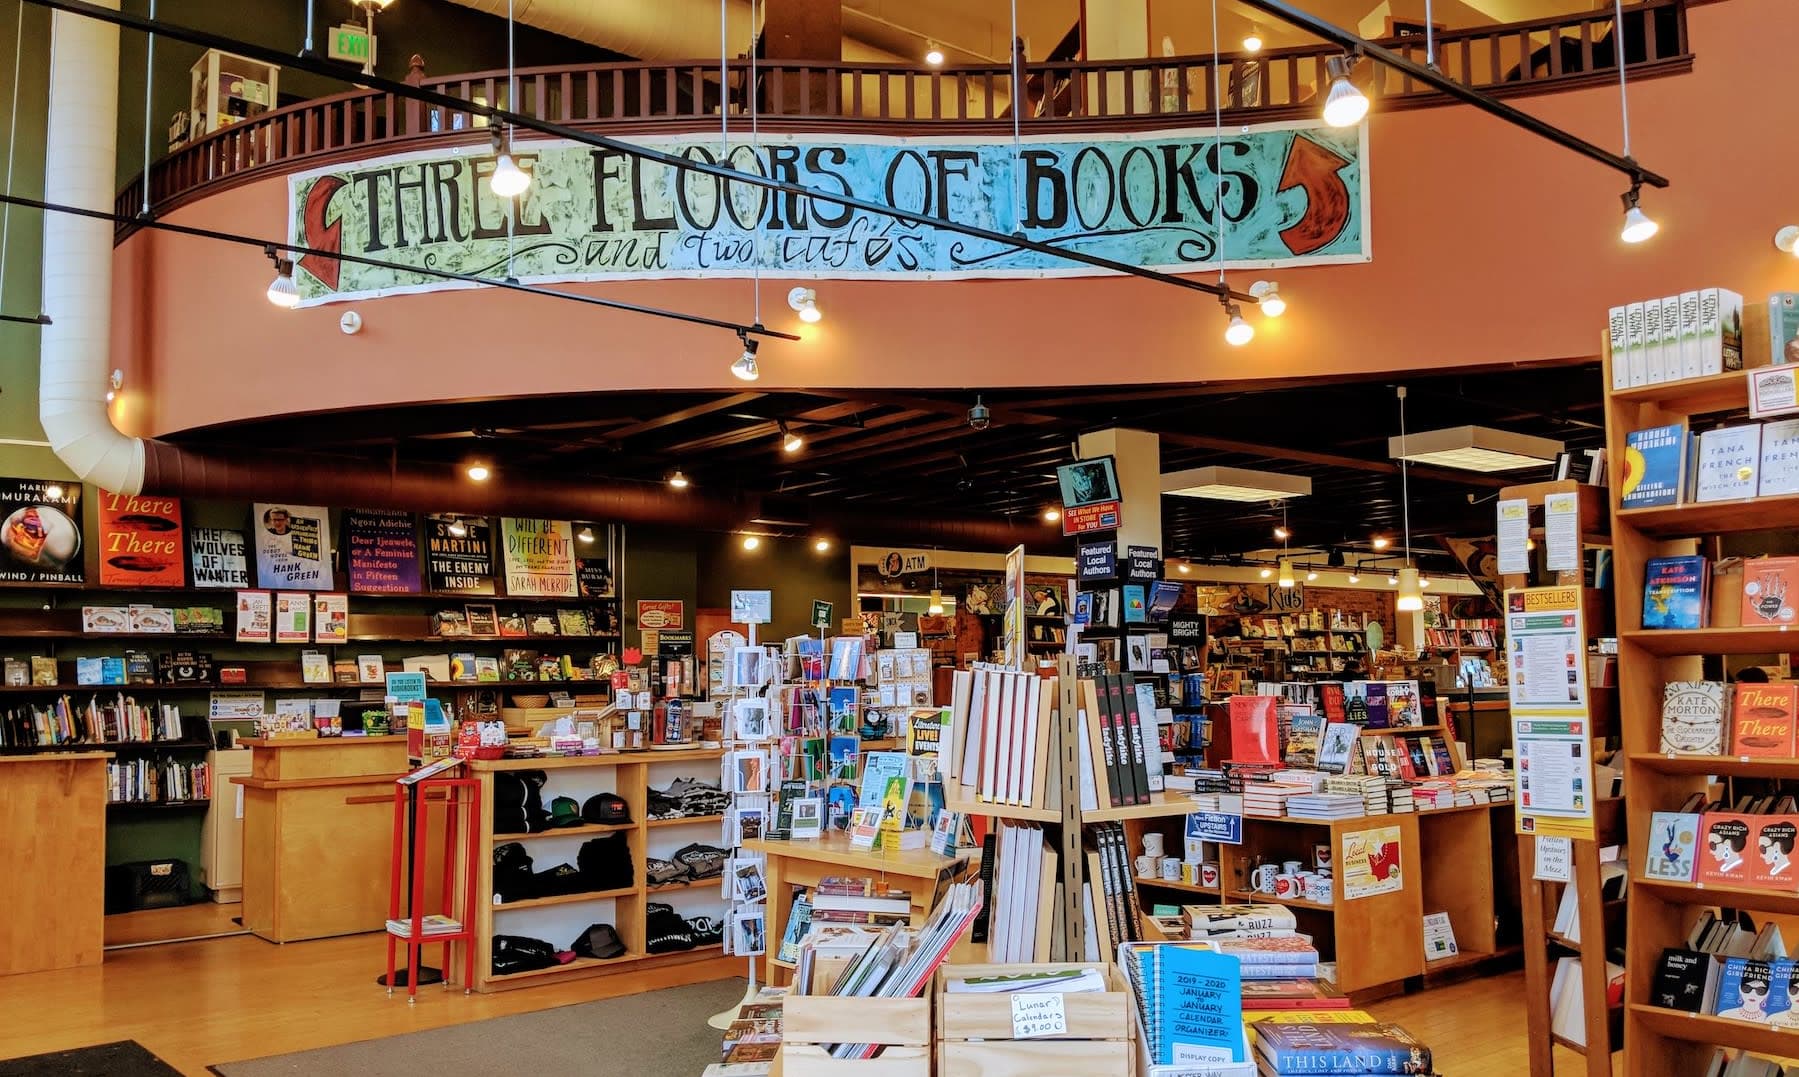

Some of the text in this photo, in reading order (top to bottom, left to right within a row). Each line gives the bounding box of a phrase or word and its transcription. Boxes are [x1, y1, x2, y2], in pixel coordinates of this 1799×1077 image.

[352, 141, 1258, 252] THREE FLOORS OF BOOKS
[583, 232, 668, 270] and
[683, 231, 756, 269] two
[1711, 444, 1745, 455] TANA
[1702, 456, 1752, 469] FRENCH
[1, 492, 76, 505] MURAKAMI
[105, 492, 174, 514] There
[195, 528, 220, 541] THE
[107, 532, 176, 554] There
[351, 536, 374, 545] Dear
[509, 534, 571, 557] DIFFERENT
[193, 542, 246, 556] WOLVES
[431, 539, 486, 554] MARTINI
[1081, 544, 1112, 556] Featured
[364, 548, 372, 556] A
[375, 548, 415, 558] Feminist
[1128, 548, 1158, 559] Featured
[202, 556, 219, 568] OF
[353, 559, 397, 569] Manifesto
[905, 556, 926, 570] ATM
[1087, 555, 1107, 565] Local
[1134, 559, 1153, 568] Local
[273, 562, 301, 573] HANK
[432, 561, 489, 574] THE ENEMY
[1083, 566, 1111, 575] Authors
[1130, 568, 1157, 578] Authors
[40, 573, 83, 582] PINBALL
[287, 570, 319, 581] GREEN
[366, 571, 398, 581] Fifteen
[1649, 576, 1696, 586] ATKINSON
[354, 583, 409, 593] Suggestions
[445, 576, 481, 589] INSIDE
[511, 576, 536, 592] SARAH
[1526, 591, 1576, 605] BESTSELLERS
[1172, 621, 1199, 629] MIGHTY
[1677, 696, 1707, 705] KATE
[1740, 690, 1788, 706] There
[1350, 711, 1367, 720] LIES
[1667, 706, 1716, 715] MORTON
[1740, 720, 1787, 735] There
[917, 730, 938, 741] LIVE!
[1366, 749, 1397, 757] HOUSE
[1372, 763, 1396, 771] GOLD
[1648, 857, 1691, 877] LESS
[1249, 919, 1273, 929] BUZZ
[1668, 955, 1698, 964] milk and
[1667, 962, 1688, 971] honey
[1727, 964, 1774, 975] CHINA RICH
[1726, 970, 1773, 981] GIRLFRIEND
[1178, 976, 1226, 988] 2019 2020
[1180, 988, 1221, 1000] JANUARY
[1019, 1001, 1051, 1011] Lunar
[1181, 1001, 1223, 1013] JANUARY
[1013, 1012, 1063, 1023] Calendars
[1179, 1013, 1224, 1025] CALENDAR
[1283, 1055, 1382, 1068] THIS LAND
